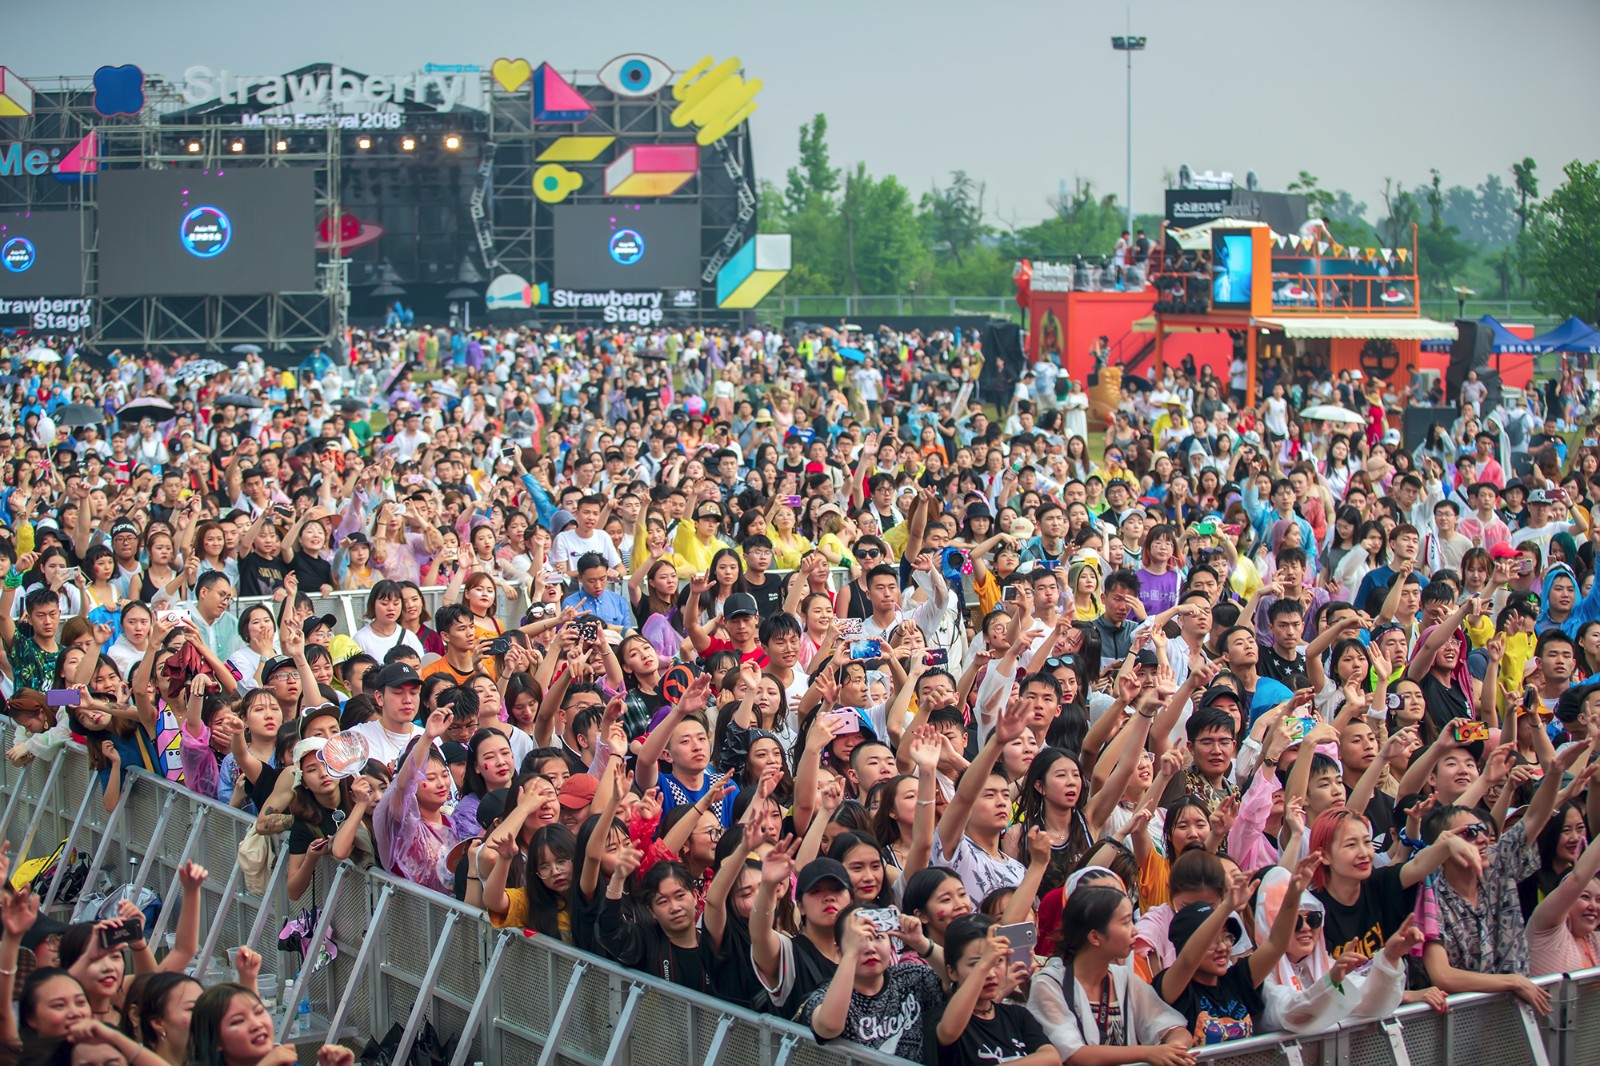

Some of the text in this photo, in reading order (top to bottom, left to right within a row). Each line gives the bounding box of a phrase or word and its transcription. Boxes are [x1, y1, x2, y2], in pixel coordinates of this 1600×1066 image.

[185, 65, 464, 112] Strawberry
[242, 112, 401, 129] Music Festival 2018
[552, 289, 663, 309] Strawberry
[33, 312, 91, 332] Stage
[603, 306, 663, 326] Stage
[859, 993, 921, 1041] Chicago
